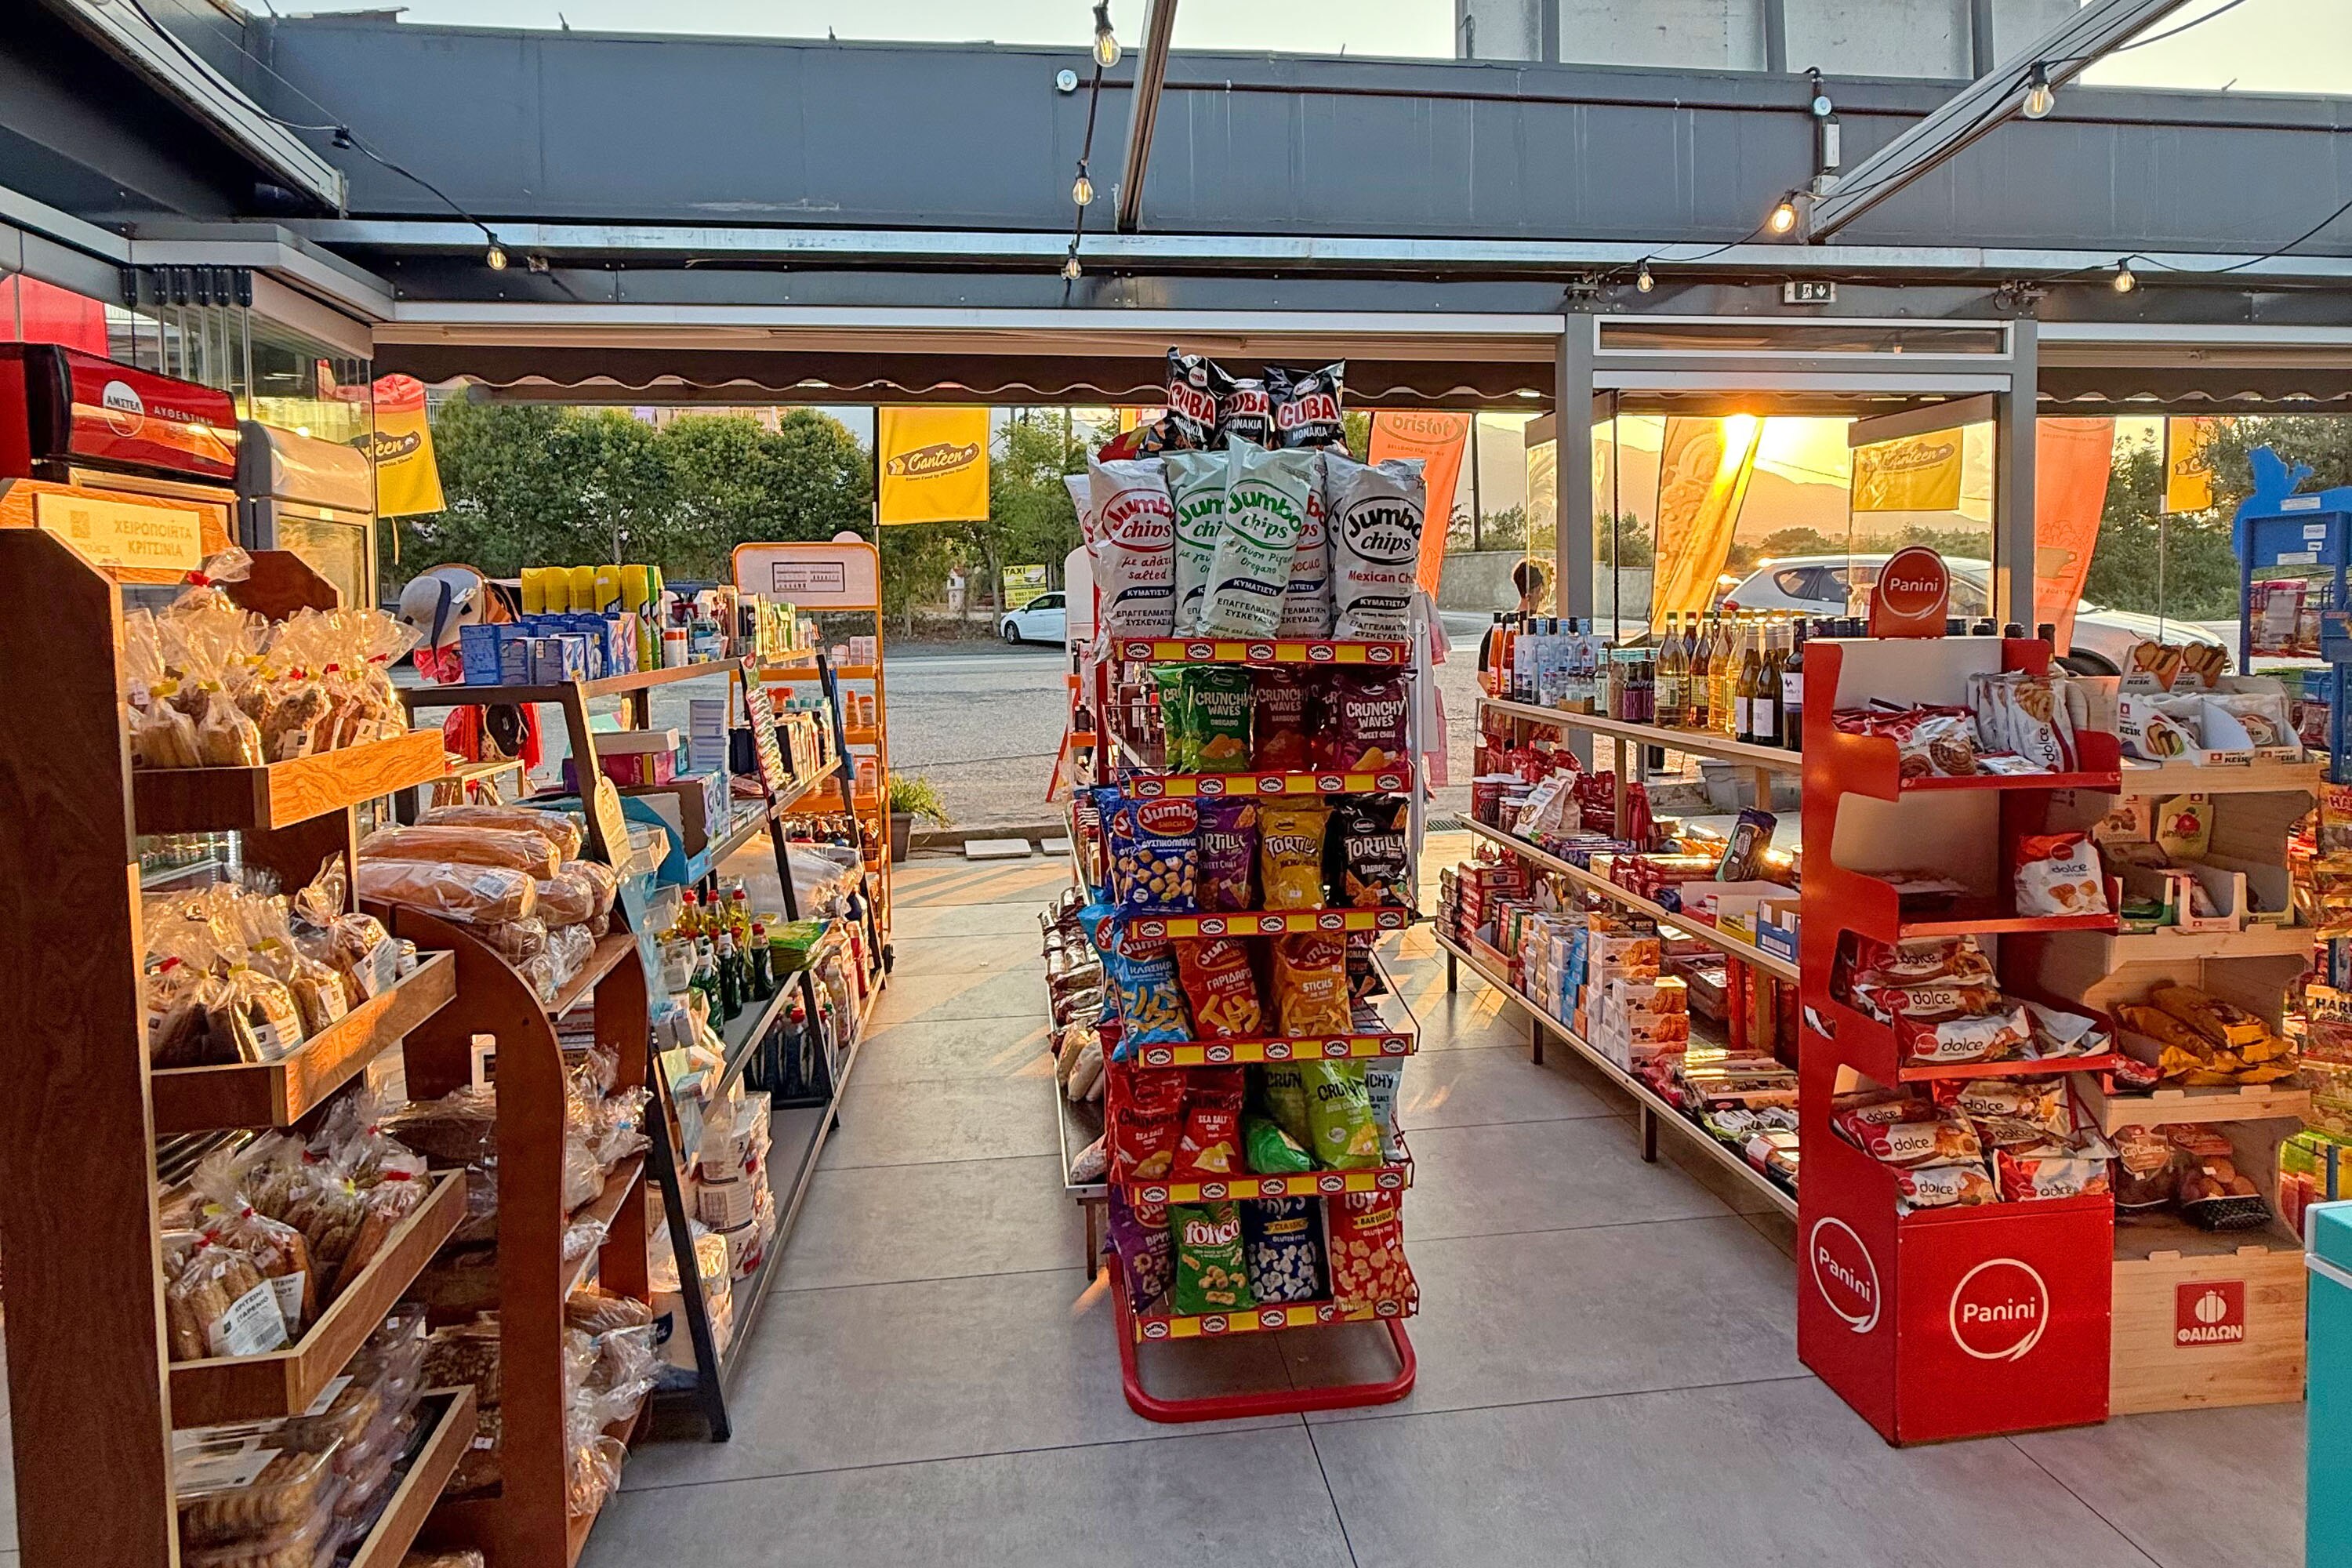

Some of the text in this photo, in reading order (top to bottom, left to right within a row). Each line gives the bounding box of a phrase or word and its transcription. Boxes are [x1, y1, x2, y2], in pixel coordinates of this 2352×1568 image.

[154, 405, 213, 426] ΑΥΘΕΝΤΙΚΗ
[1279, 396, 1338, 427] CUBA
[908, 448, 964, 471] Canteen
[1229, 491, 1301, 532] Jumbo
[1241, 513, 1287, 539] chips
[1348, 508, 1422, 539] Jumbo
[1361, 532, 1411, 555] chips
[1004, 567, 1025, 575] TAXI
[1127, 568, 1167, 580] salted
[1348, 571, 1396, 583] Mexican
[1233, 579, 1276, 596] ΚΥΜΑΤΙΣΤΑ
[1889, 577, 1940, 593] Panini
[1127, 644, 1149, 653] Jumbo
[1189, 645, 1210, 654] Jumbo
[1250, 646, 1272, 655] Jumbo
[1310, 647, 1331, 655] Jumbo
[1370, 648, 1391, 656] Jumbo
[1207, 706, 1240, 716] WAVES
[1269, 701, 1301, 712] WAVES
[1345, 699, 1406, 718] CRUNCHY
[1358, 715, 1394, 728] WAVES
[1358, 731, 1378, 739] SWEET
[1200, 780, 1221, 789] Jumbo
[1261, 779, 1281, 787] Jumbo
[1319, 777, 1341, 786] Jumbo
[1378, 776, 1399, 785] Jumbo
[1143, 804, 1198, 823] Jumbo
[1344, 836, 1405, 861] TORTILLA
[1261, 917, 1283, 927] Jumbo
[1320, 915, 1341, 924] Jumbo
[1379, 913, 1399, 922] Jumbo
[1142, 923, 1163, 931] Jumbo
[1202, 920, 1223, 929] Jumbo
[1267, 1044, 1288, 1053] Jumbo
[1327, 1042, 1347, 1051] Jumbo
[1384, 1040, 1404, 1048] Jumbo
[1149, 1050, 1170, 1059] Jumbo
[1208, 1047, 1229, 1055] Jumbo
[1267, 1073, 1301, 1088] CRUN
[1198, 1115, 1228, 1123] SEA SALT
[1321, 1178, 1342, 1186] Jumbo
[1379, 1174, 1399, 1183] Jumbo
[1203, 1185, 1225, 1193] Jumbo
[1262, 1181, 1283, 1189] Jumbo
[1144, 1188, 1165, 1196] Jumbo
[1819, 1245, 1871, 1302] Panini
[1963, 1296, 2036, 1323] Panini
[2177, 1325, 2242, 1342] ΦΑΙΔΩΝ
